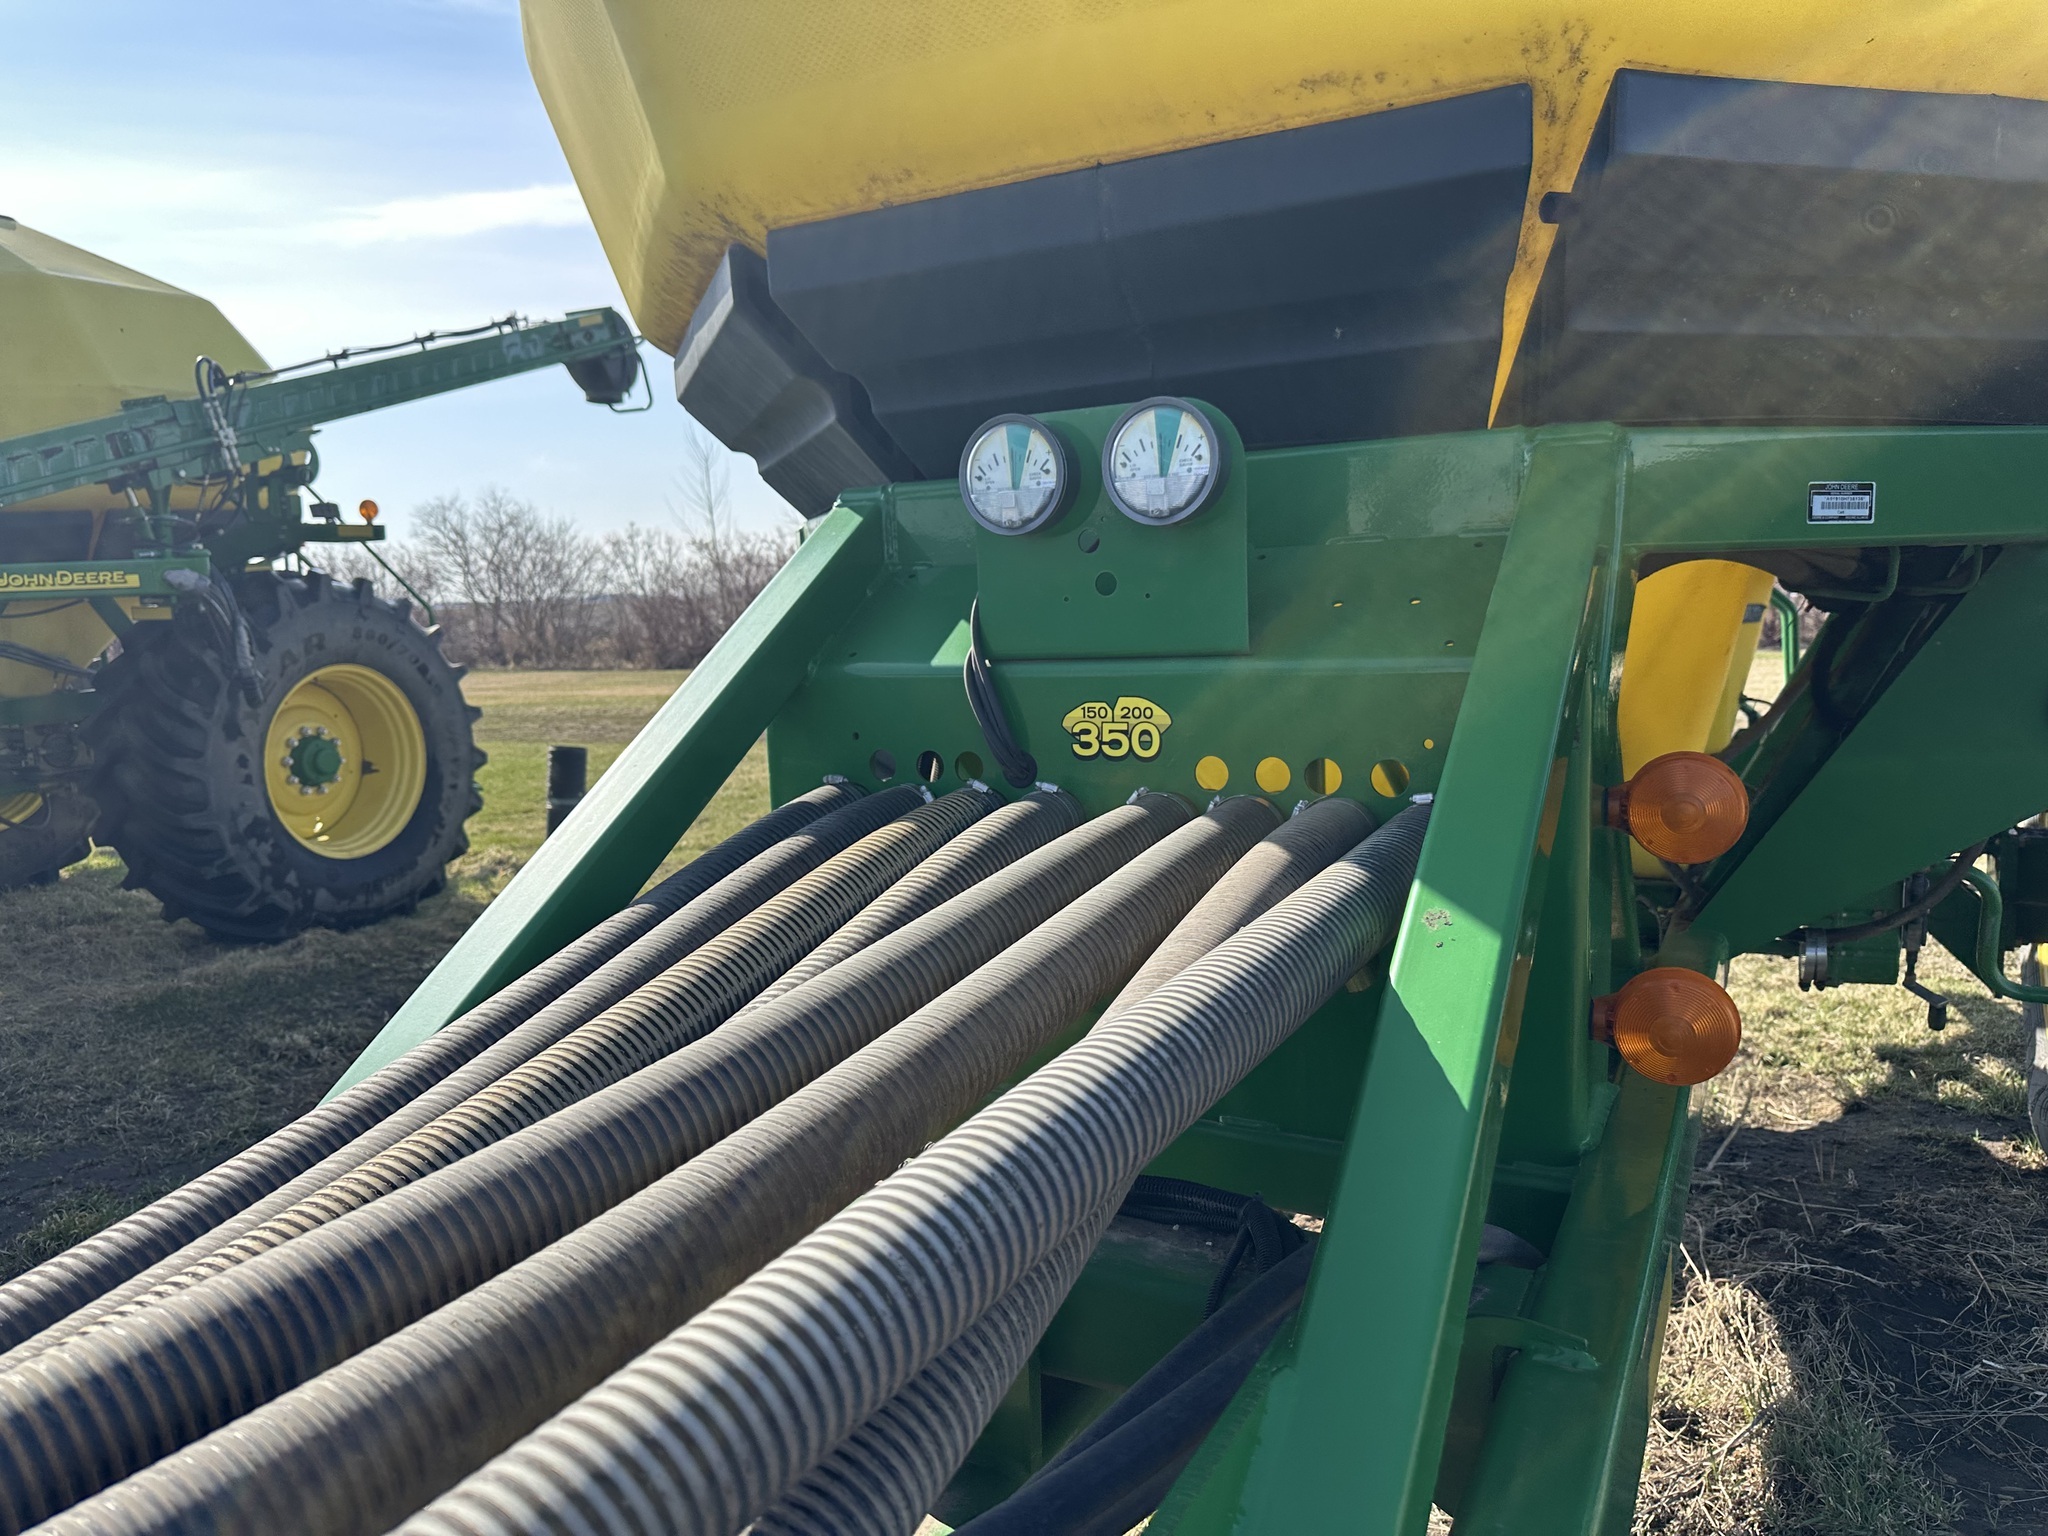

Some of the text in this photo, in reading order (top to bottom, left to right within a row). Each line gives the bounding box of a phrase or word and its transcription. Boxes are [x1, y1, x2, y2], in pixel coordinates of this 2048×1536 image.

[0, 570, 125, 587] JOHN DEERE
[1081, 706, 1154, 719] 150 200
[1072, 721, 1161, 760] 350
